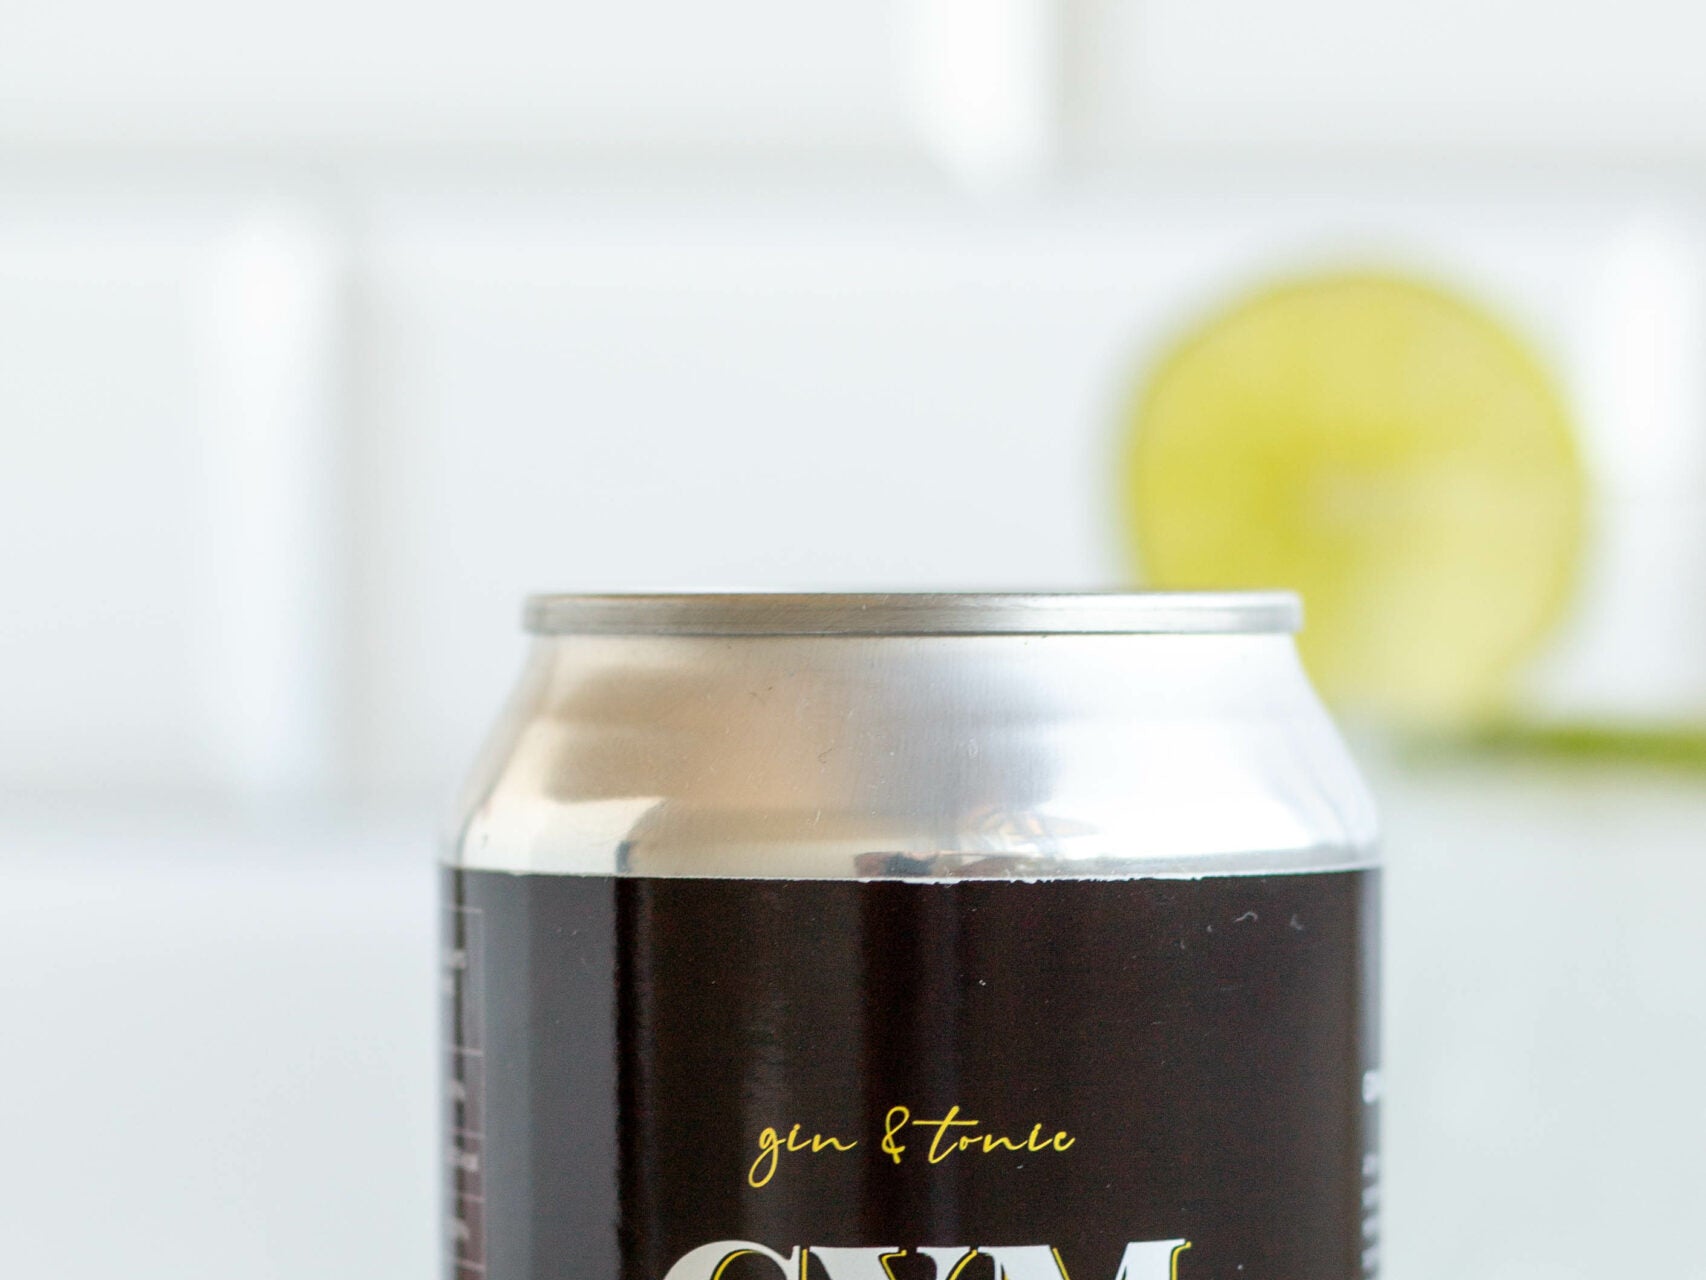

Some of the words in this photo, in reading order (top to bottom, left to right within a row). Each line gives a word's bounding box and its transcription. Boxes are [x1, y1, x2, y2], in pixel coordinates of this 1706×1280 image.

[747, 1124, 858, 1189] gin
[881, 1105, 910, 1164] &
[911, 1105, 1077, 1164] tonic
